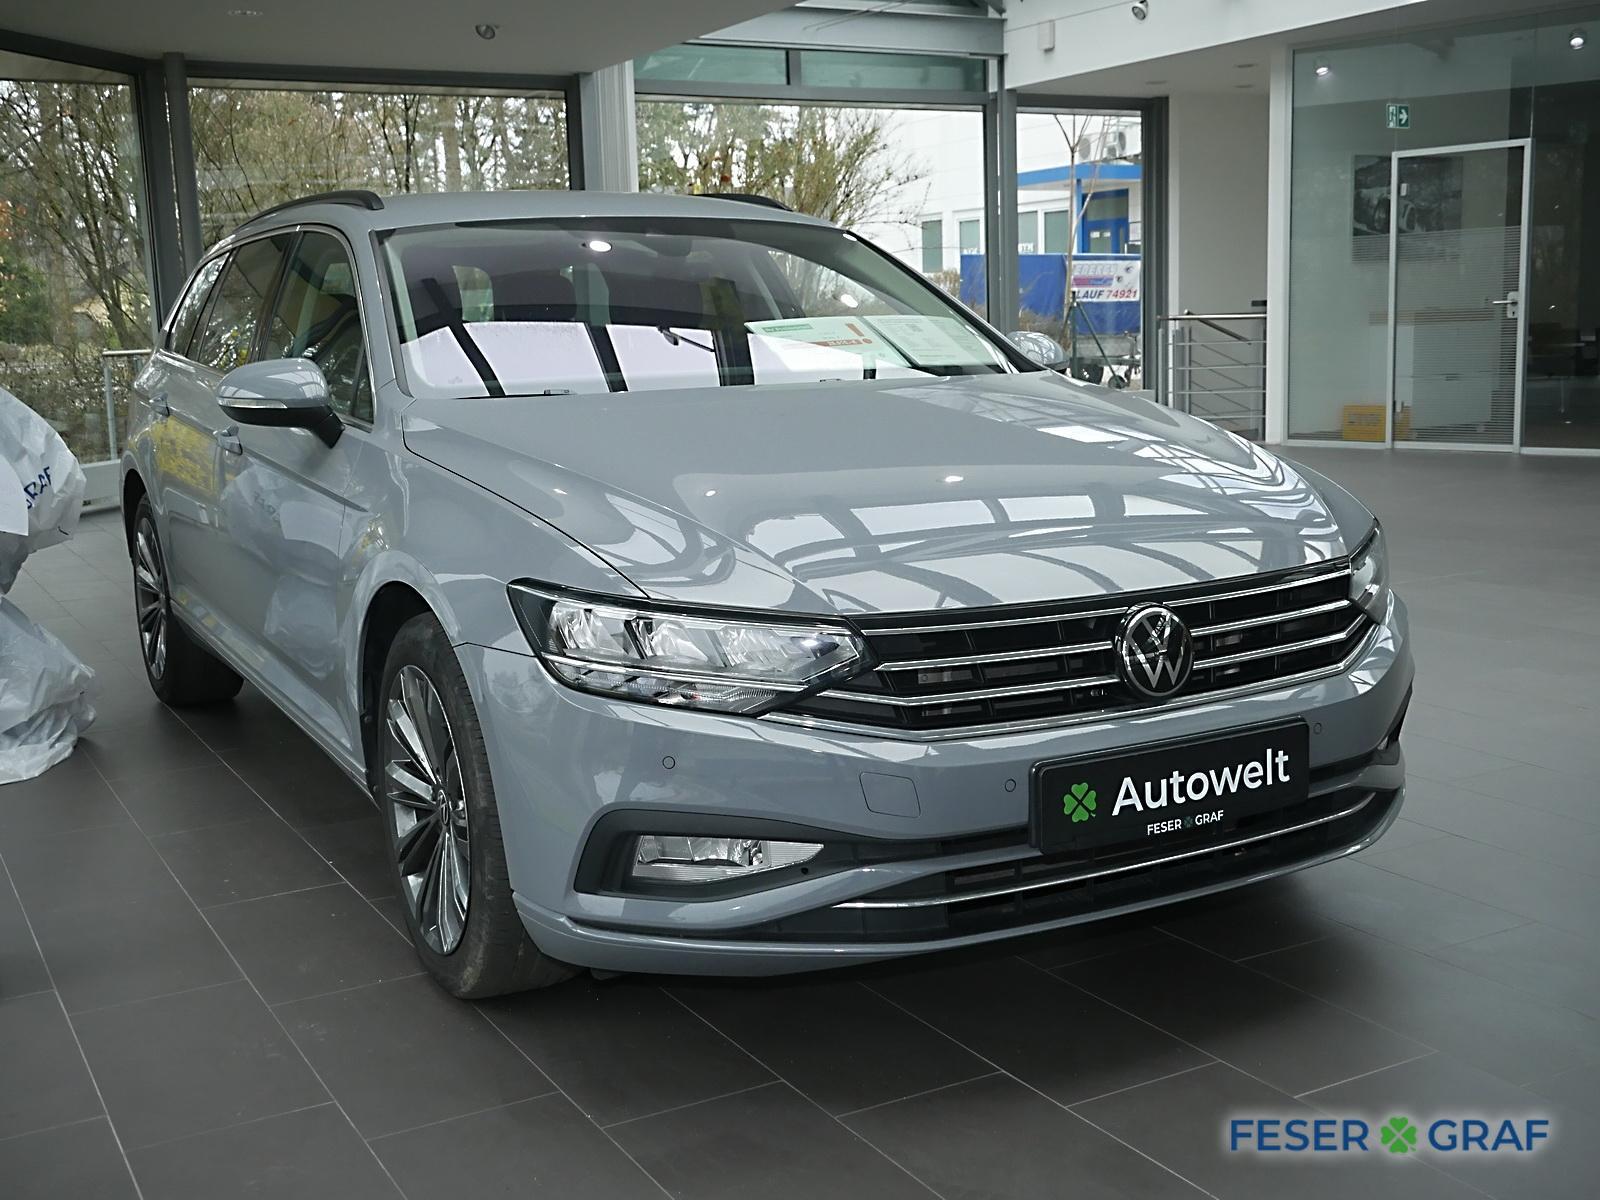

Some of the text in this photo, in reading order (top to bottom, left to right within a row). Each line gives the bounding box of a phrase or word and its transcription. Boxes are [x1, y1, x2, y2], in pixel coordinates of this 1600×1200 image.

[1076, 289, 1138, 299] LAUF 74921
[1124, 608, 1188, 691] VW
[1111, 748, 1291, 817] Autowelt
[1147, 809, 1224, 836] FESER GRAF
